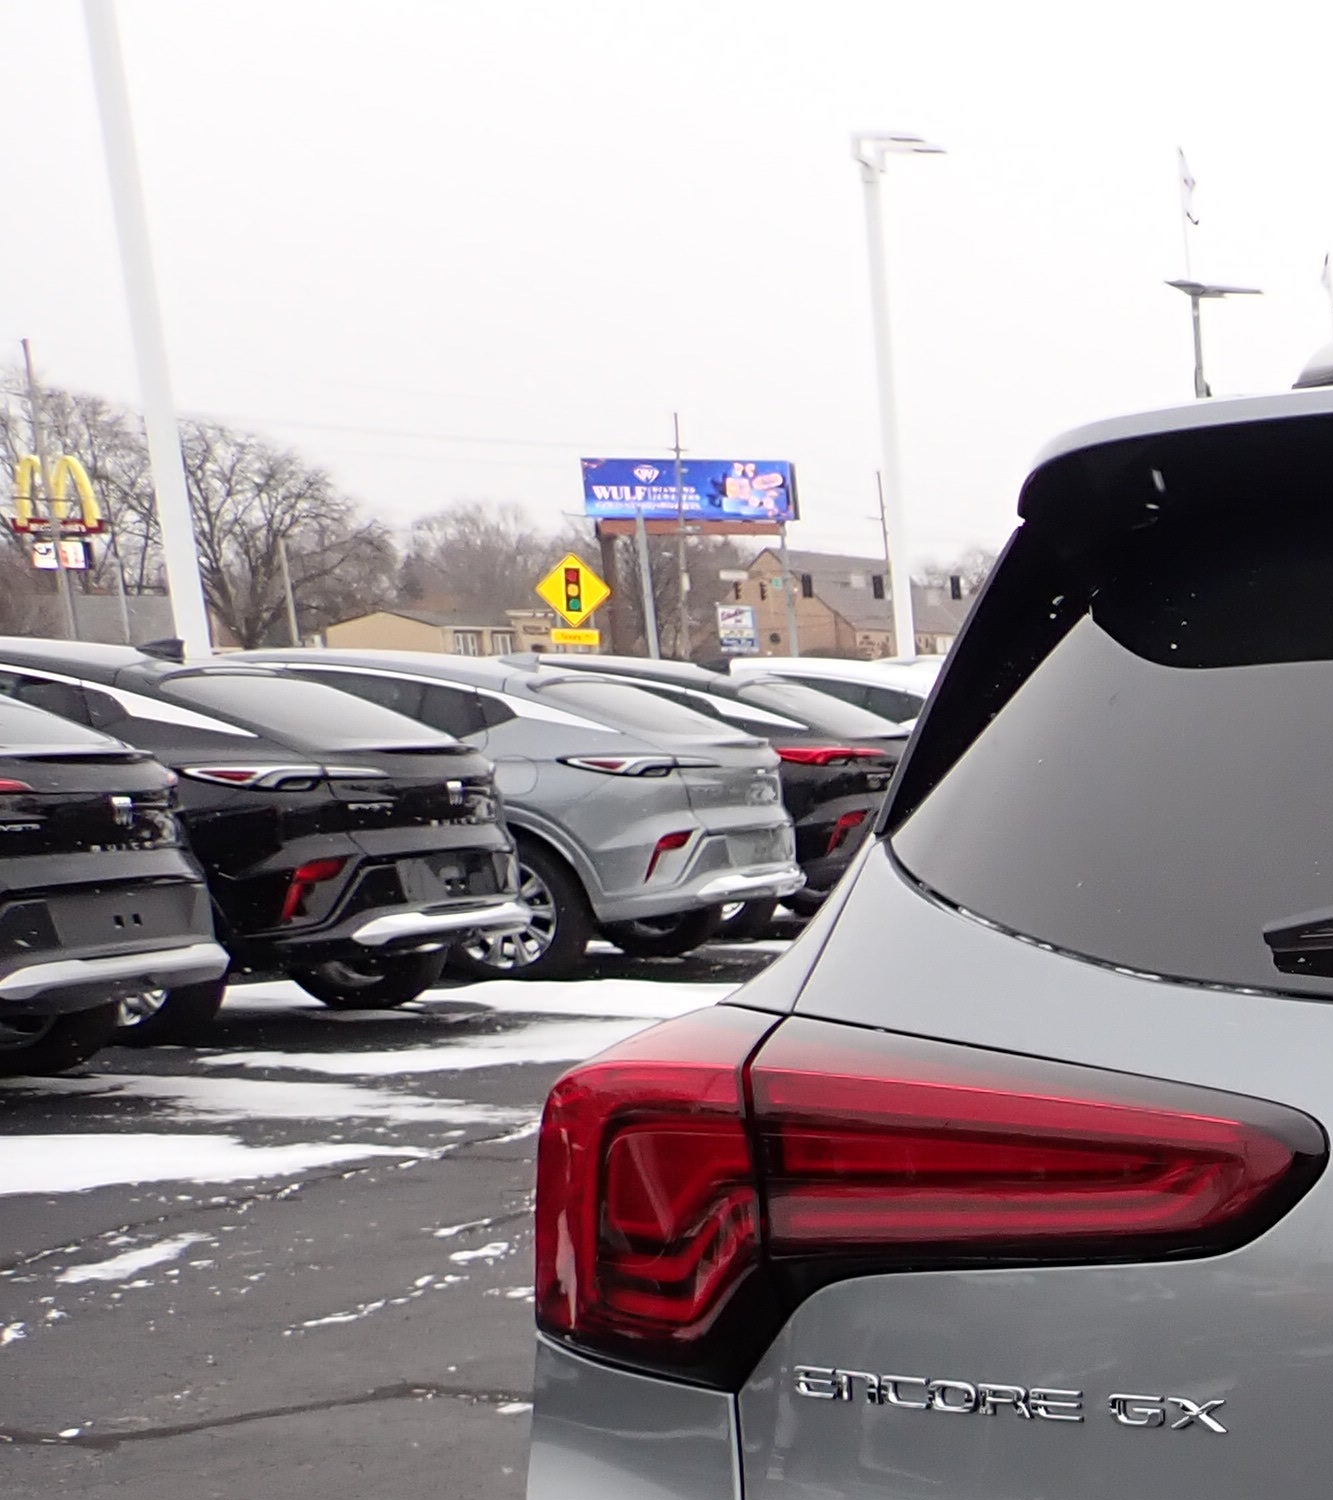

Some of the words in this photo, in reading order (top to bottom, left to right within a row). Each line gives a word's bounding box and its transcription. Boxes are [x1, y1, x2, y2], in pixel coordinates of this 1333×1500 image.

[592, 485, 648, 501] WULF
[794, 1364, 1085, 1423] ENCORE
[1108, 1392, 1229, 1434] GX
